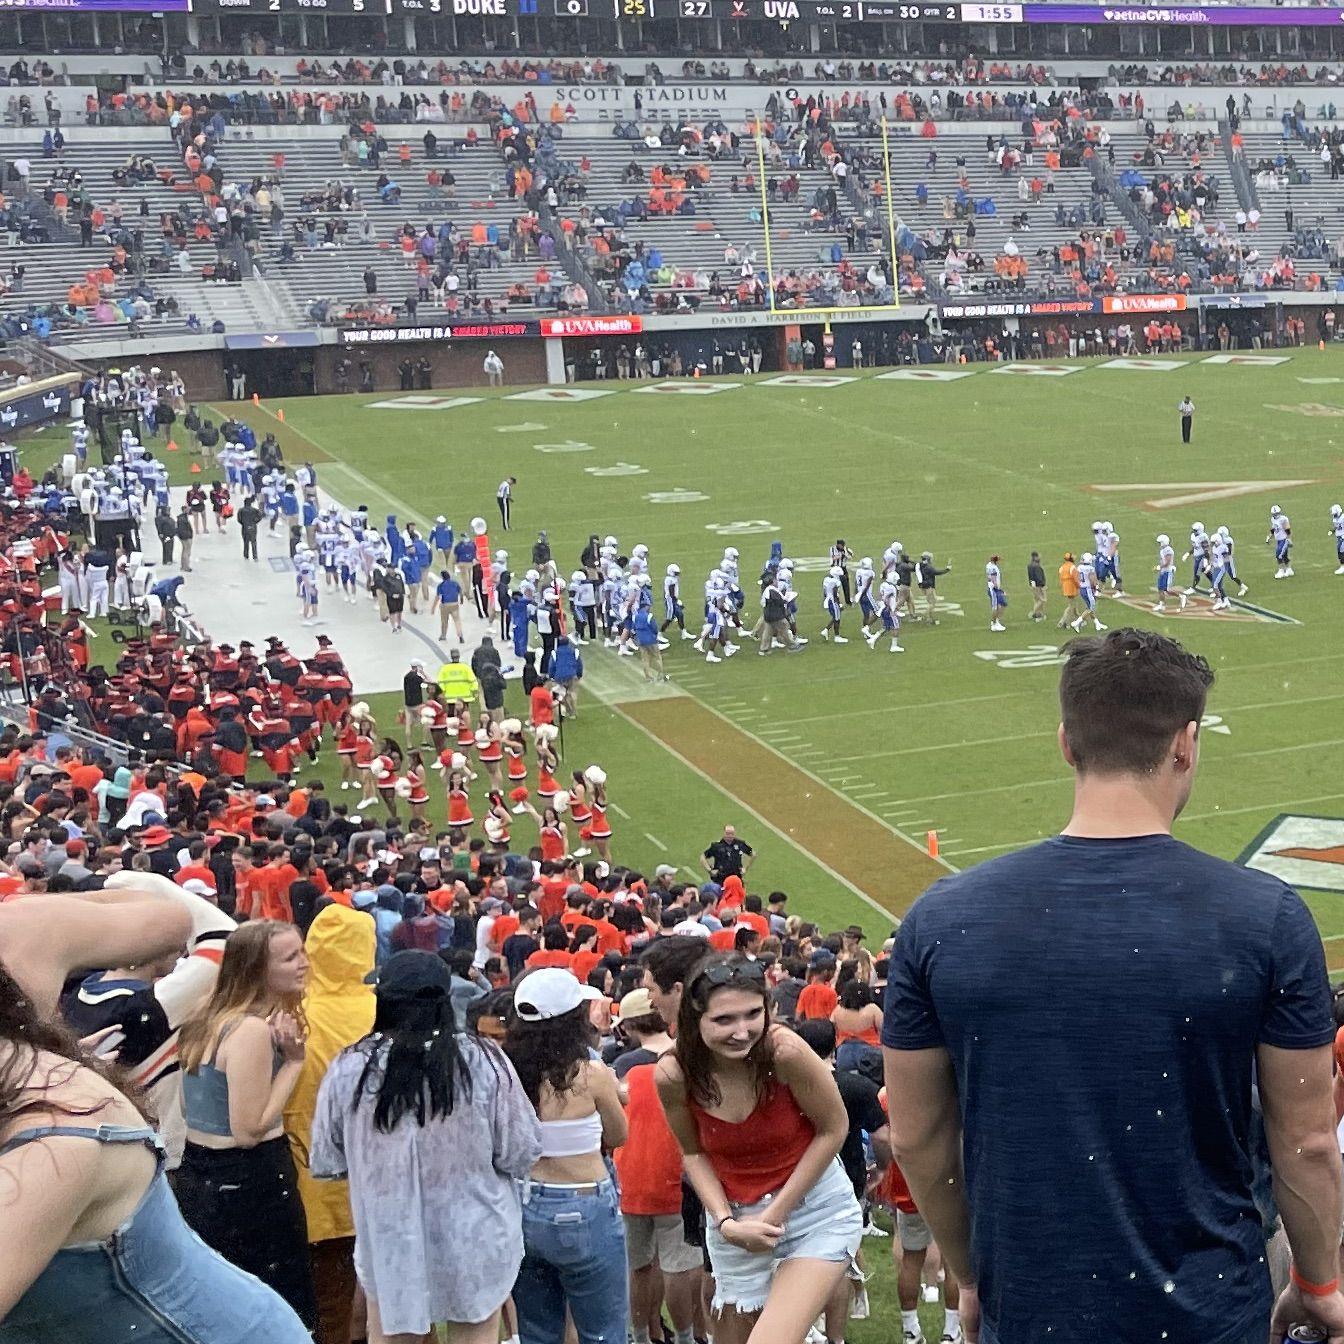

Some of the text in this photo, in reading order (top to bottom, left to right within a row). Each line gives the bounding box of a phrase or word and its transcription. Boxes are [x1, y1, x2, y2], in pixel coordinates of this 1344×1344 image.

[623, 0, 645, 15] 25
[684, 2, 706, 16] 27
[764, 1, 800, 19] UVA
[842, 5, 852, 18] 2
[900, 5, 920, 19] 30
[946, 6, 956, 19] 2
[978, 6, 1013, 19] 1:55
[556, 88, 728, 102] SCOTT STADIUM
[711, 315, 747, 325] DAVID
[766, 312, 821, 323] HARRISON
[343, 330, 369, 342] YOUR
[370, 329, 397, 341] GOOD
